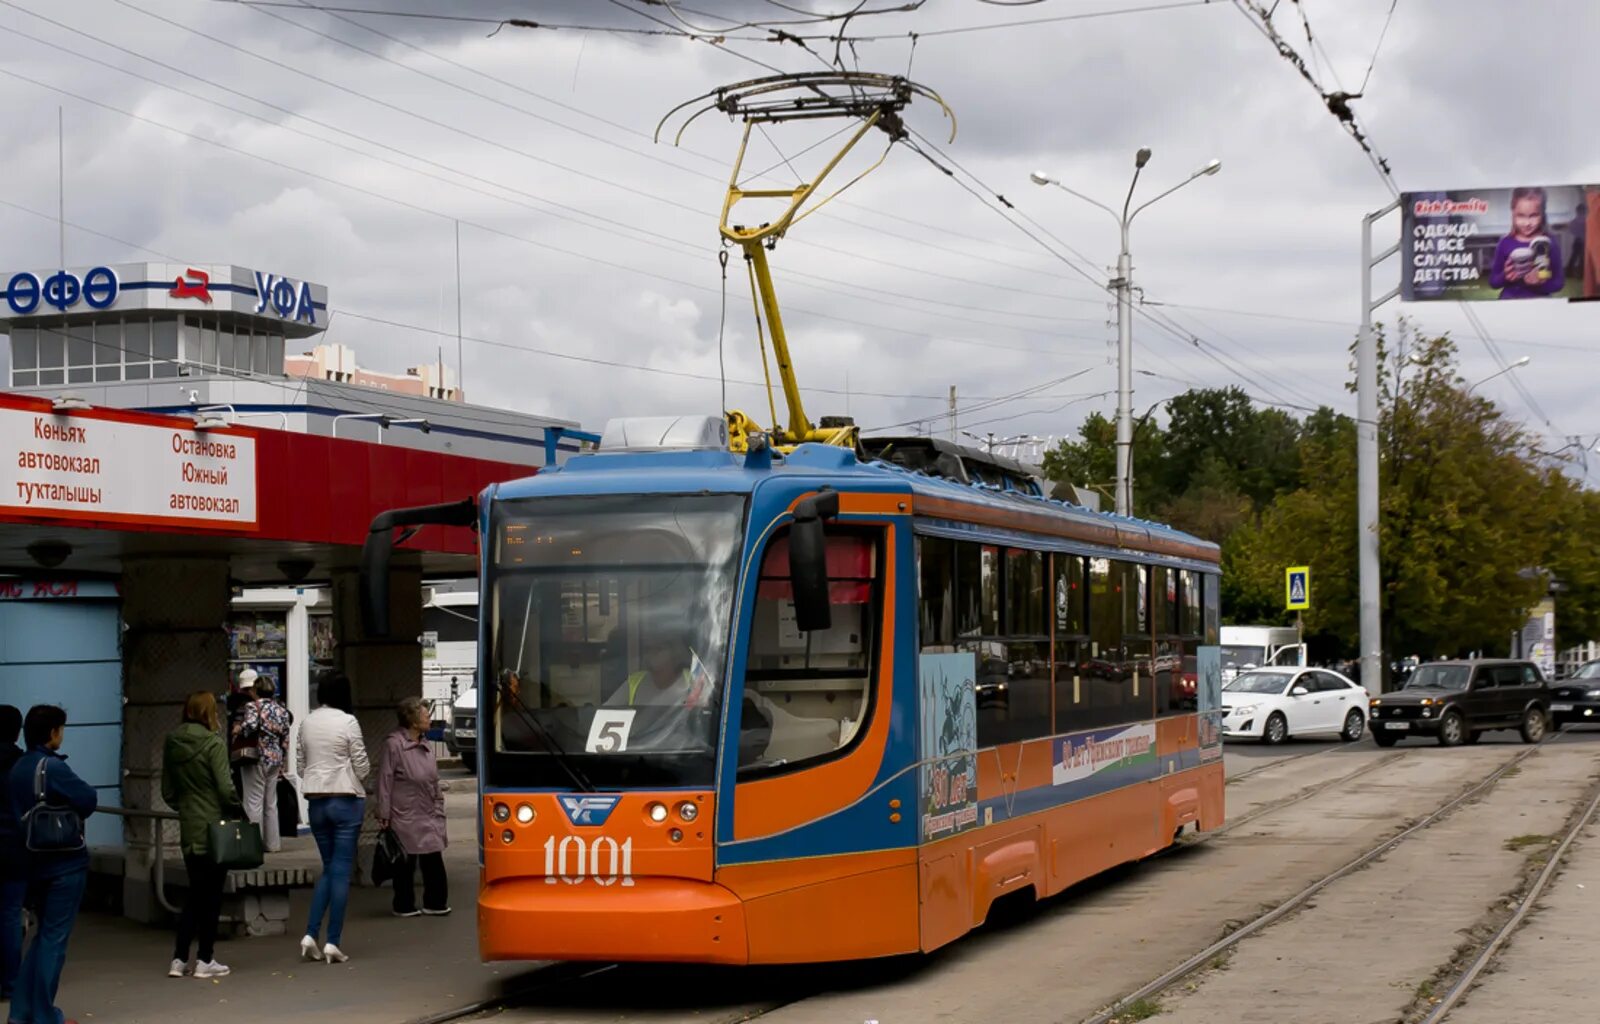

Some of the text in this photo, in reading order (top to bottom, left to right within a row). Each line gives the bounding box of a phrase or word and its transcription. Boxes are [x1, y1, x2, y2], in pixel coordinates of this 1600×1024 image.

[1413, 224, 1479, 239] ОДЕЖДА
[1414, 238, 1465, 252] НА ВСЕ
[1413, 267, 1480, 284] ДЕТСТВА
[254, 271, 317, 324] УФА
[172, 432, 236, 459] Остановка
[18, 451, 100, 474] автовокзал
[182, 462, 228, 485] Южный
[170, 493, 239, 514] автовокзал
[595, 721, 625, 753] 5
[544, 835, 635, 887] 1001
